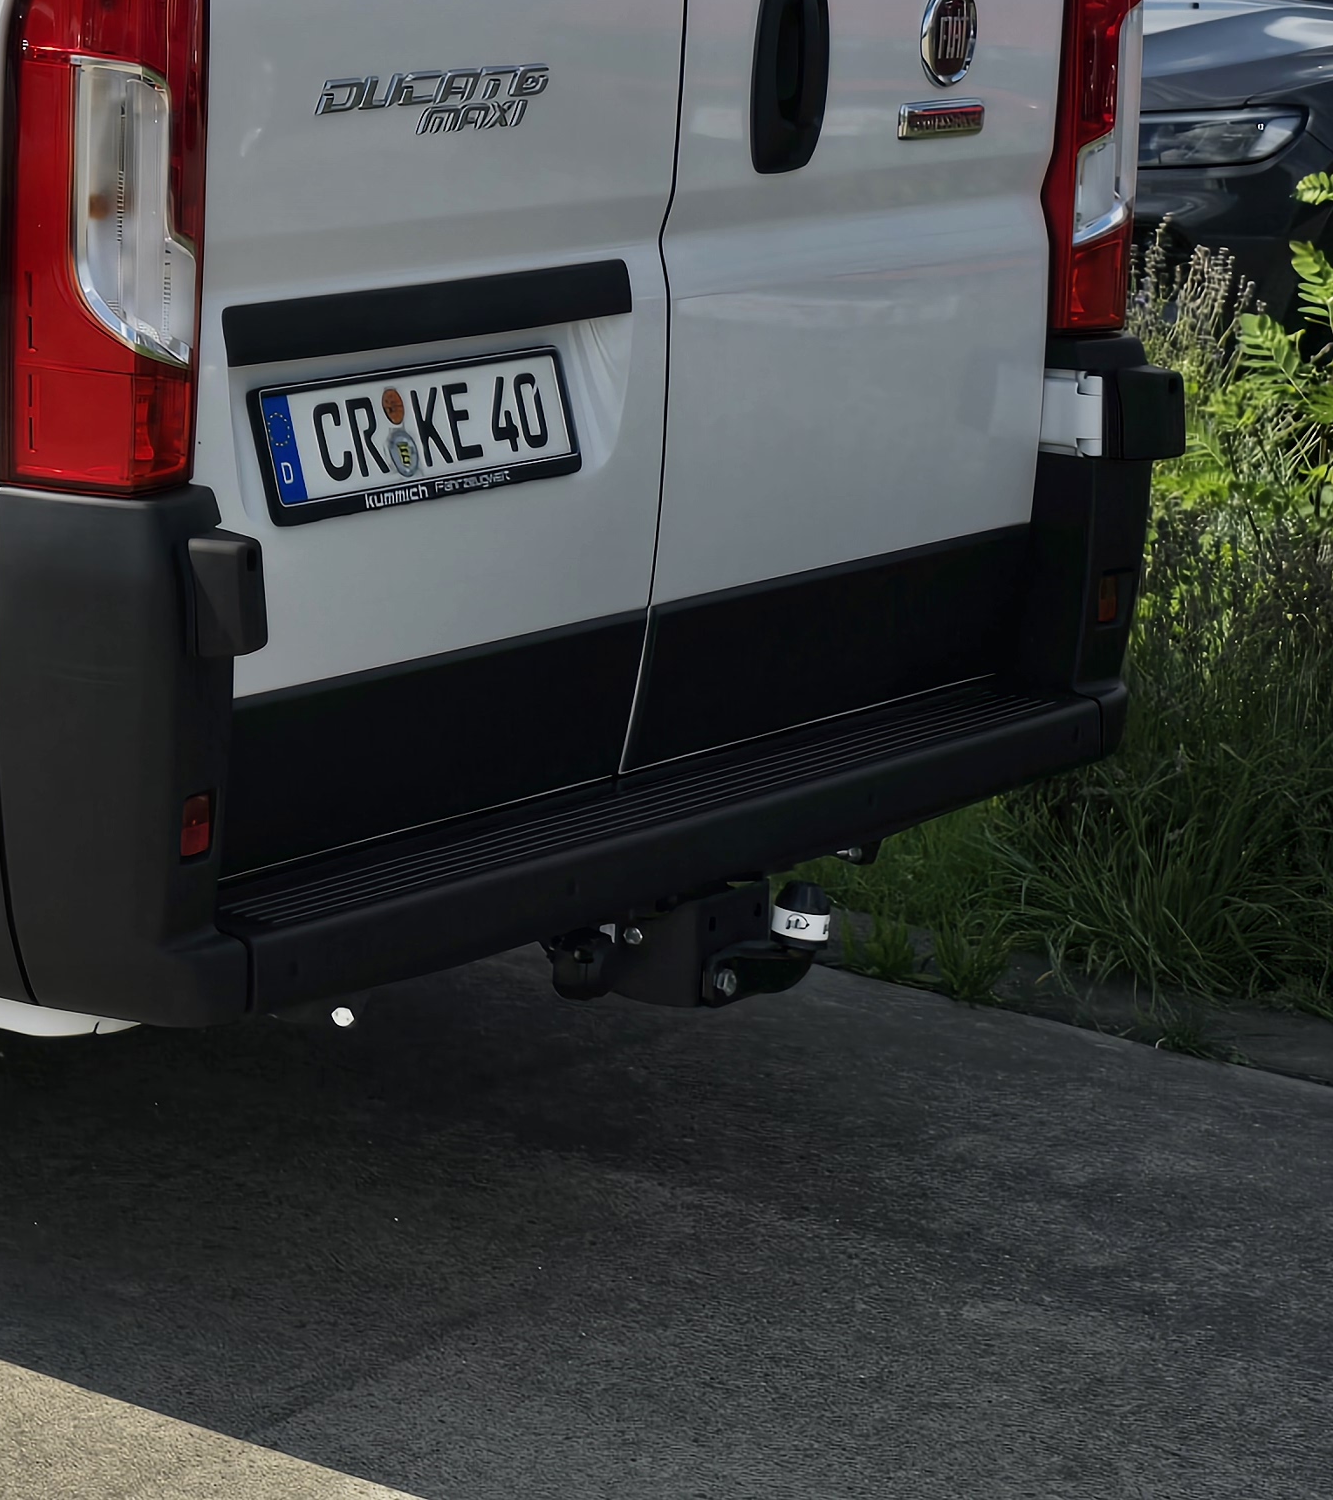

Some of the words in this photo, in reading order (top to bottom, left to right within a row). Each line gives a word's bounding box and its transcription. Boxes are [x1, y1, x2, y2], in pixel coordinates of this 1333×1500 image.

[314, 63, 549, 116] DUCATO
[415, 100, 528, 135] MAXI
[313, 396, 390, 481] CR
[410, 382, 484, 468] KE
[492, 372, 549, 453] 40
[280, 462, 295, 485] D
